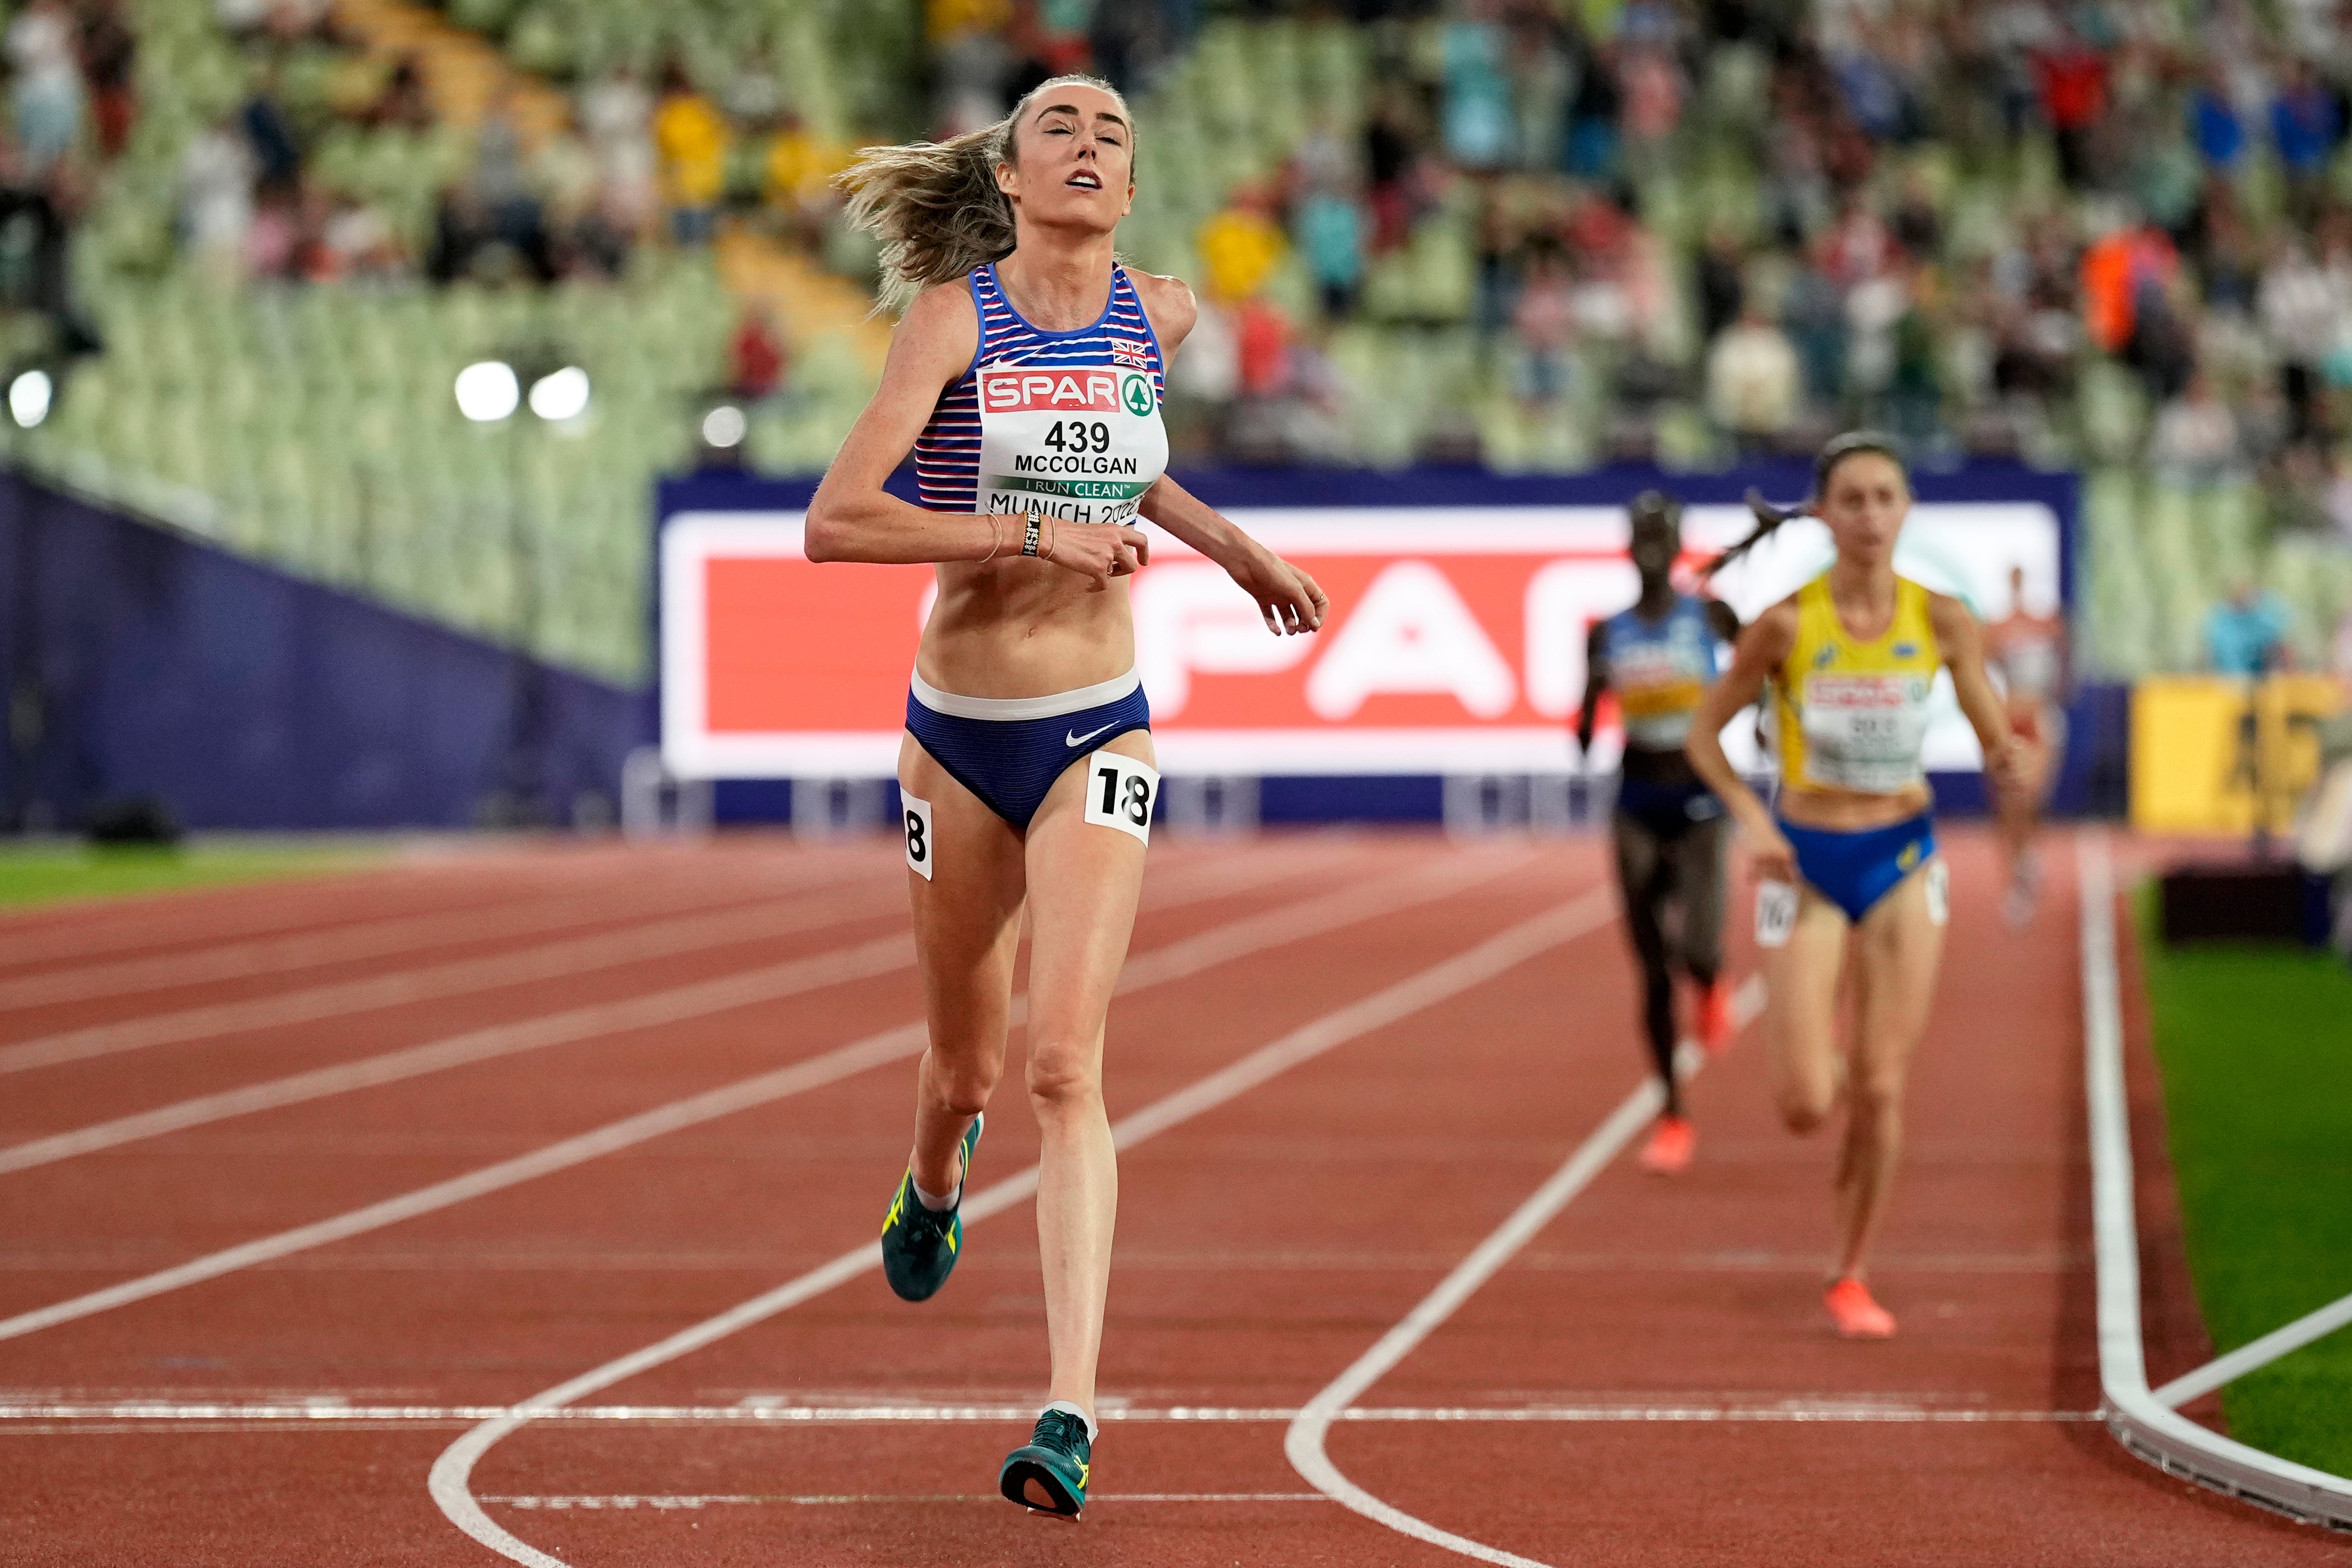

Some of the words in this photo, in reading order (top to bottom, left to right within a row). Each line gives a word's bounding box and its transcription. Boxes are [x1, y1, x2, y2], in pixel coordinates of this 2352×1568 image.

[987, 375, 1117, 407] SPAR
[1044, 421, 1110, 453] 439
[1015, 455, 1137, 474] MCCOLGAN
[1026, 479, 1029, 489] I
[1035, 480, 1070, 495] RUN
[990, 493, 1091, 524] MUNICH
[1097, 768, 1150, 826] 18
[904, 809, 926, 862] 8
